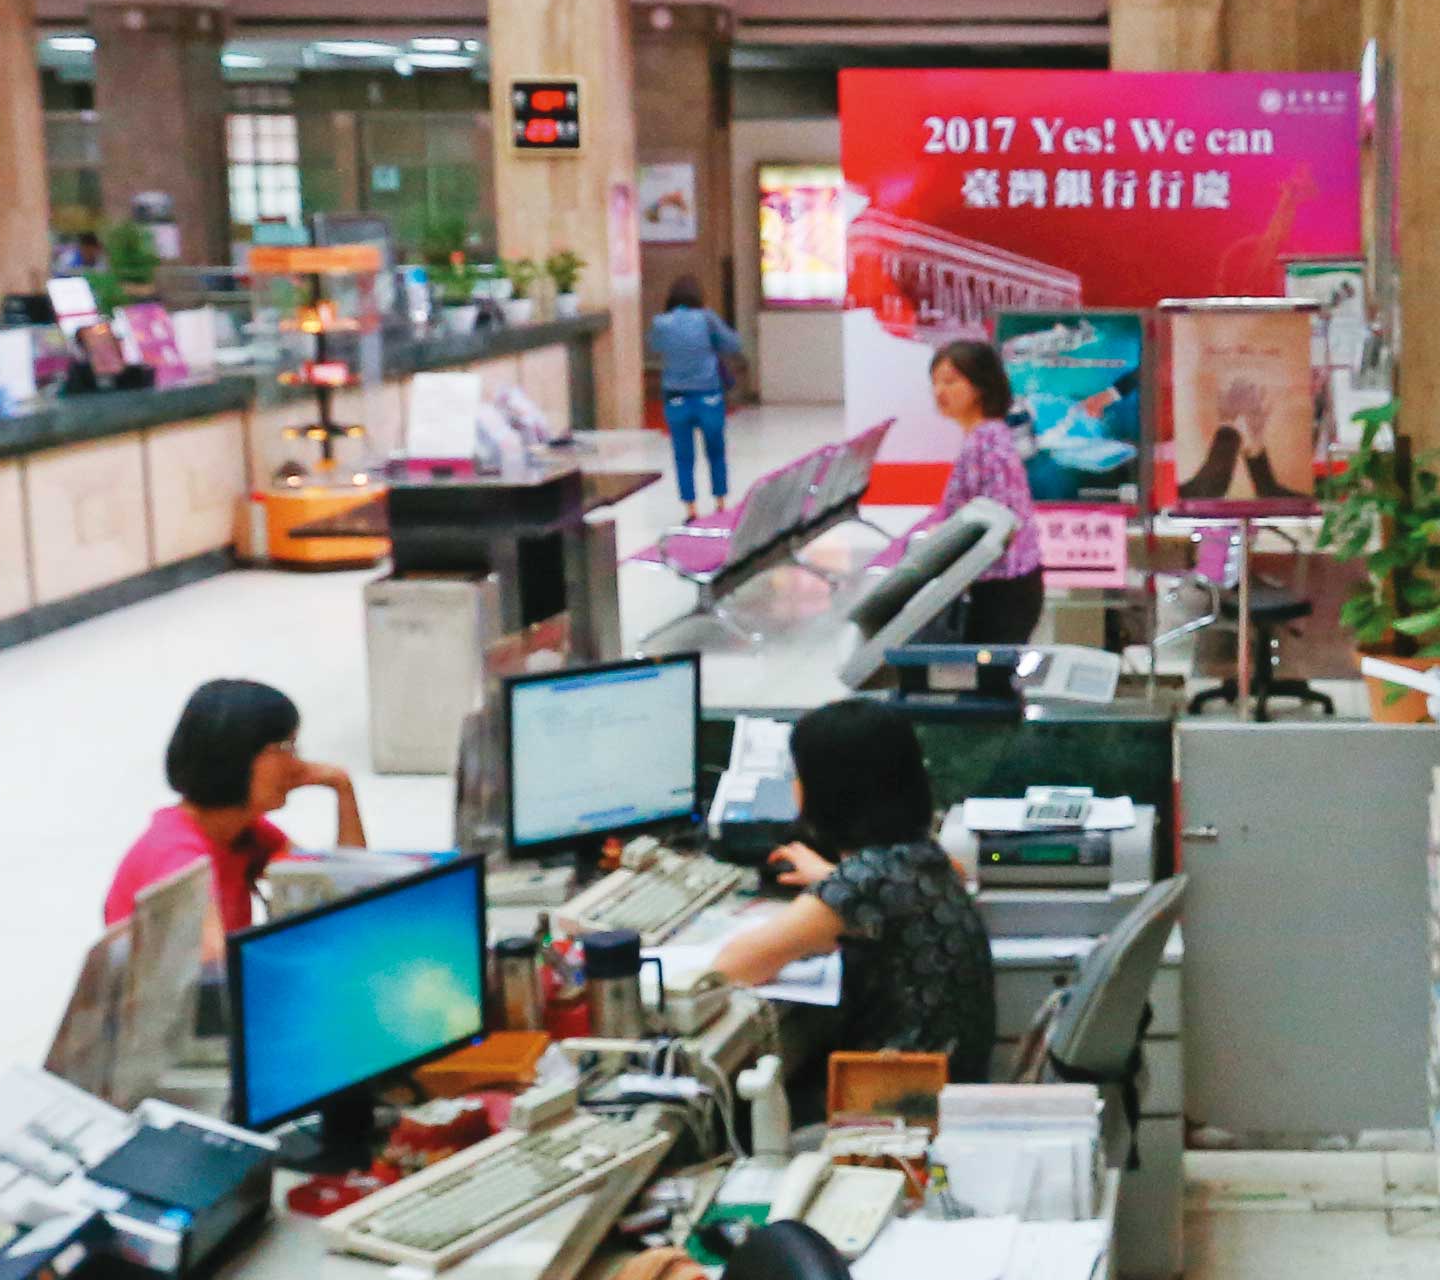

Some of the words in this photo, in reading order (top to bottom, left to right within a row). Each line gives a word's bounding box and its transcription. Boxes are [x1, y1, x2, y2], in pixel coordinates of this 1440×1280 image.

[923, 116, 1014, 155] 2017
[1030, 116, 1116, 155] Yes!
[1130, 117, 1194, 155] We
[1205, 125, 1275, 155] can
